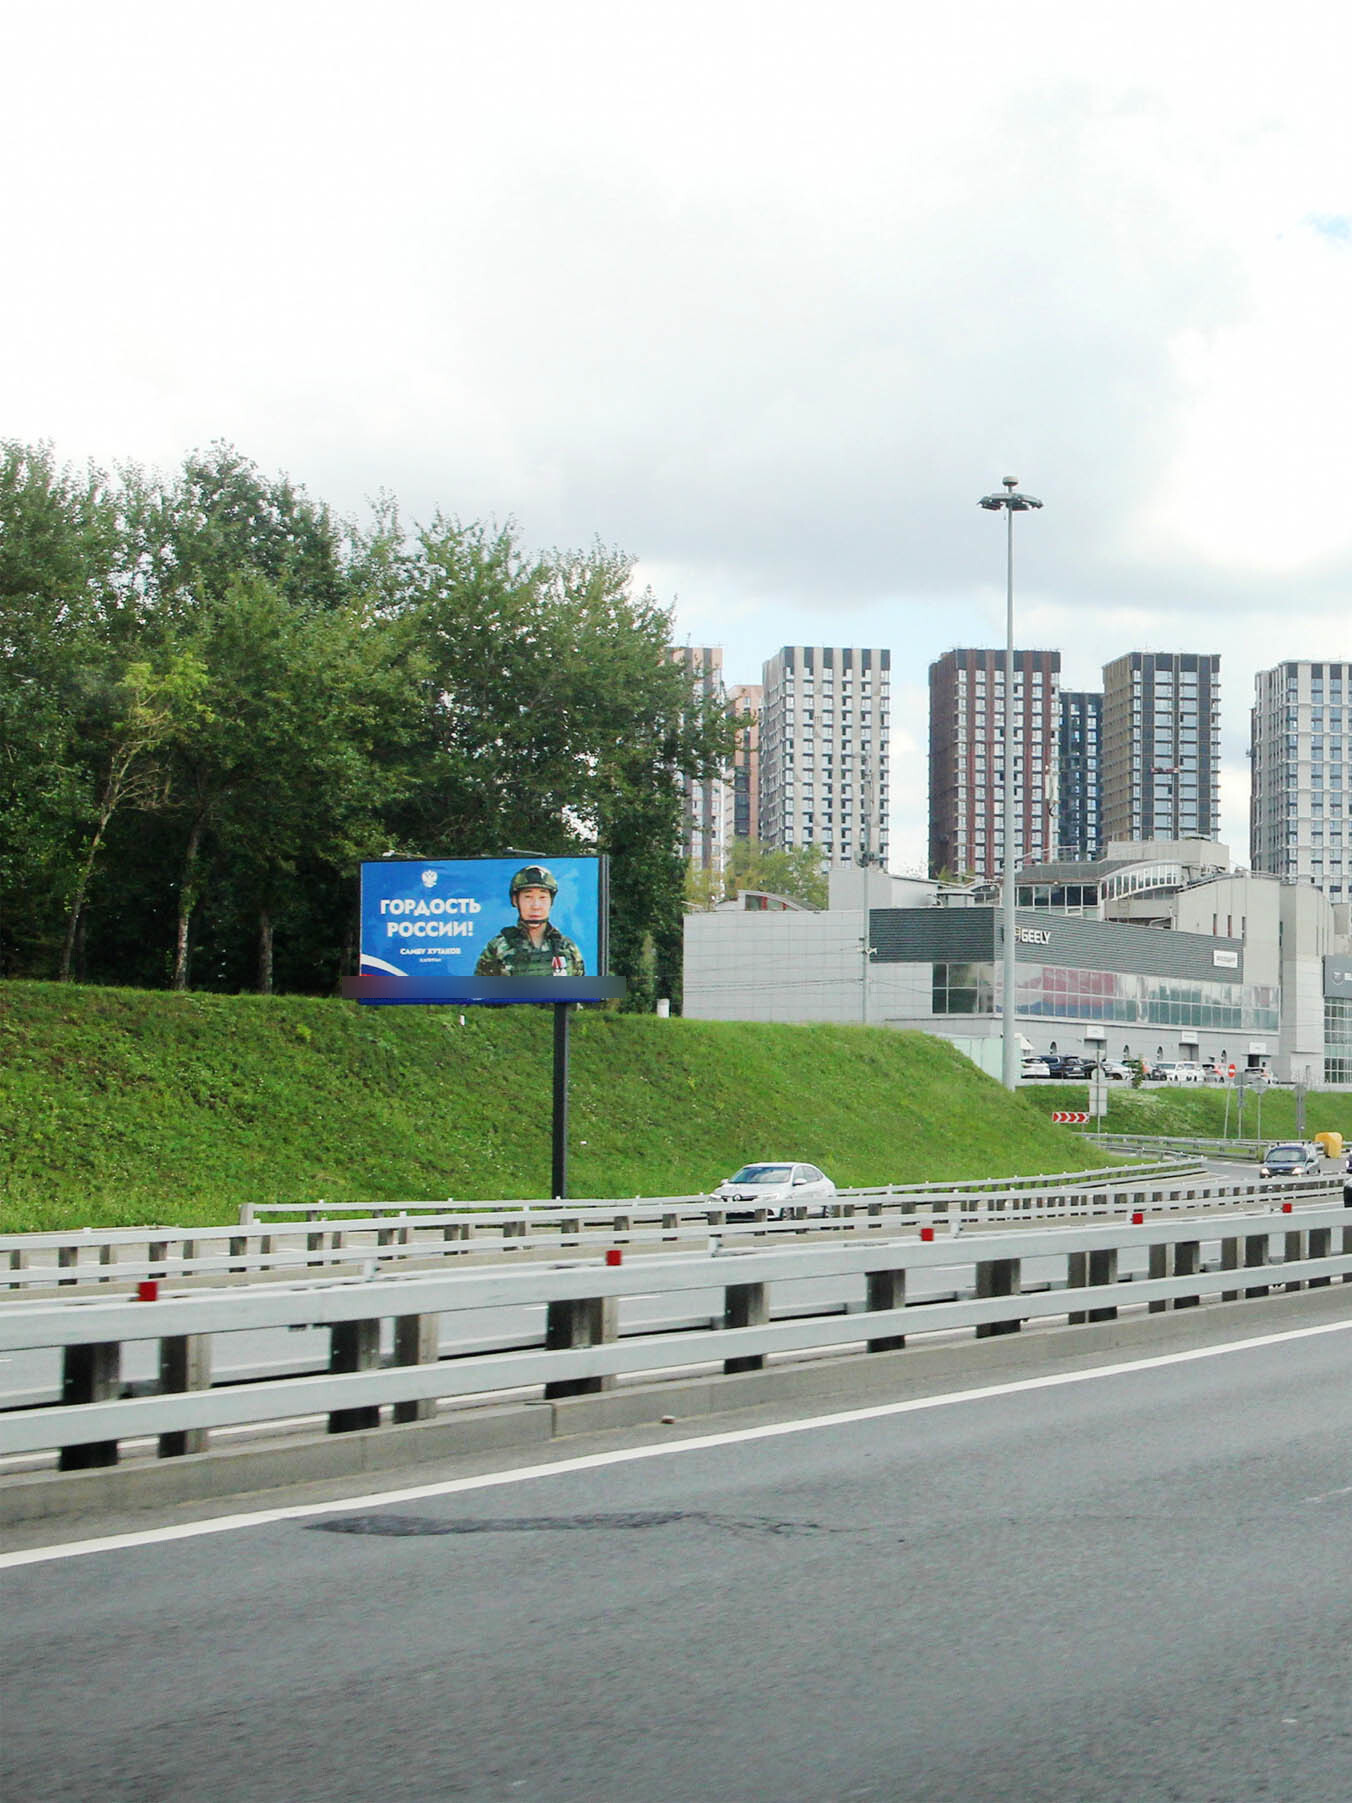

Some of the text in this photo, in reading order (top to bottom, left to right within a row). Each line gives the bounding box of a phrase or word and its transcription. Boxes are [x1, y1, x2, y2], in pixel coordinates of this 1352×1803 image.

[380, 898, 482, 916] ГОРДОСТЬ
[386, 921, 474, 937] РОССИИ!
[1021, 928, 1051, 945] GEELY
